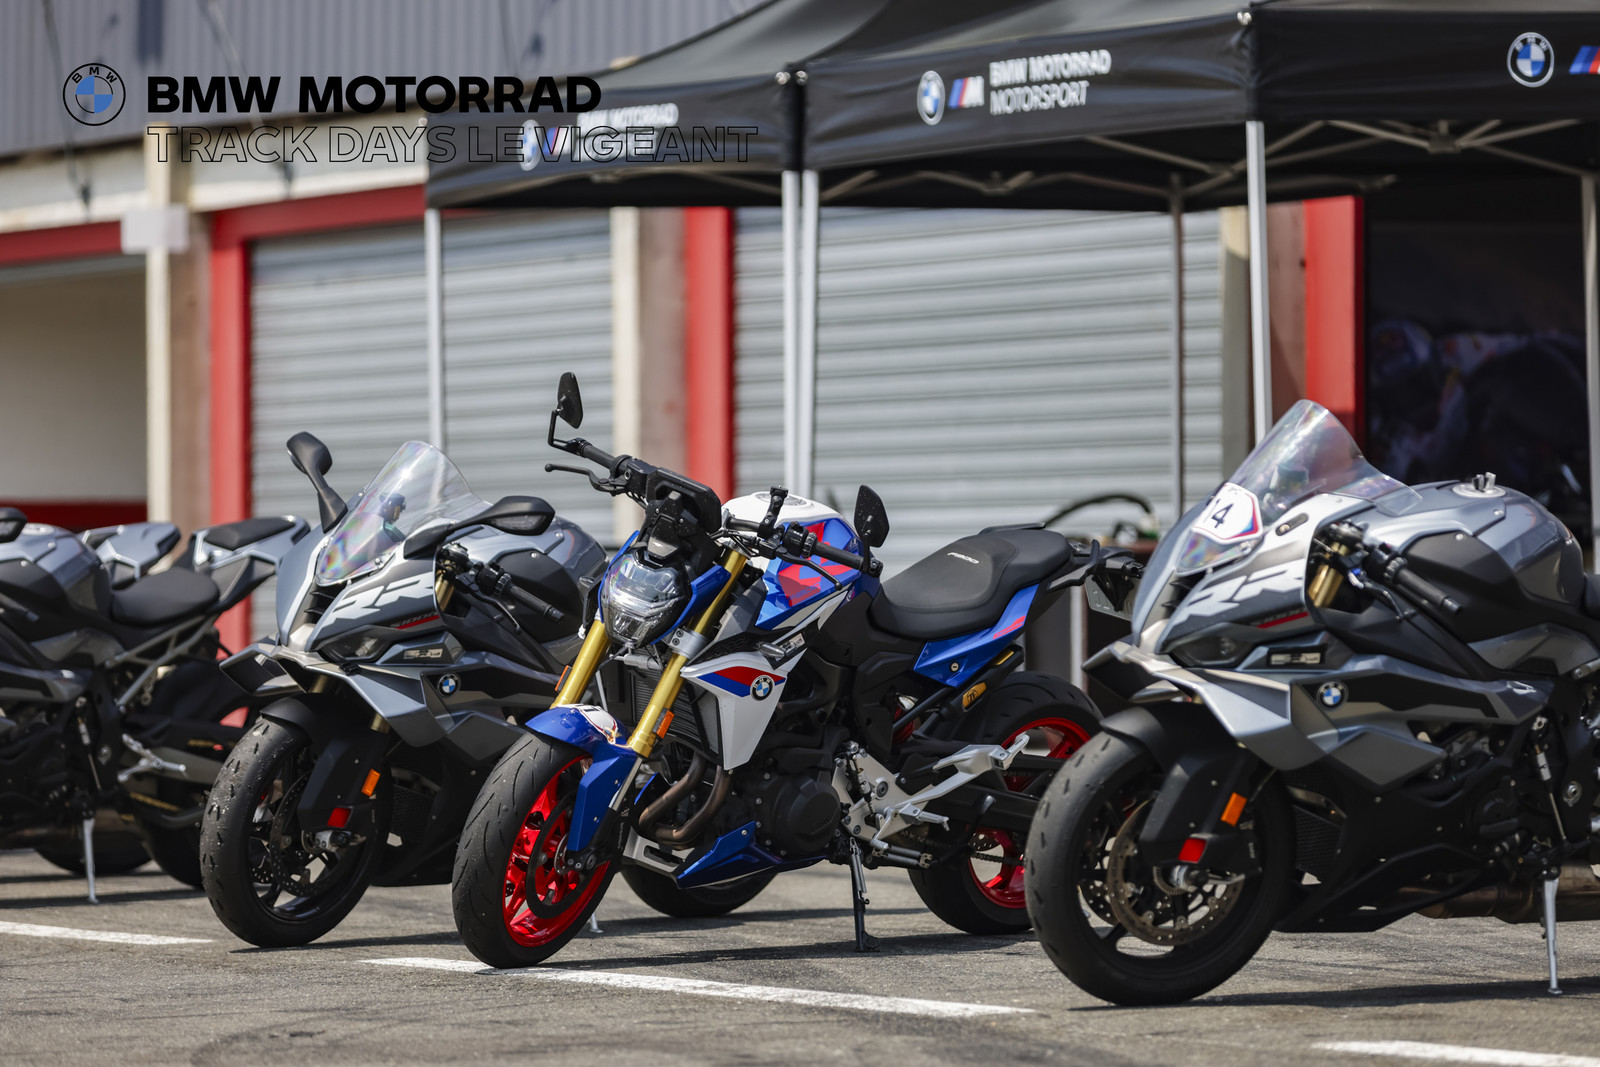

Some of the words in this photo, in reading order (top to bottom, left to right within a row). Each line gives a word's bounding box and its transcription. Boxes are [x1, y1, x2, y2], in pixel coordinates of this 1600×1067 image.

[989, 58, 1028, 87] BMW
[1028, 49, 1112, 82] MOTORRAD
[989, 80, 1090, 115] MOTORSPORT
